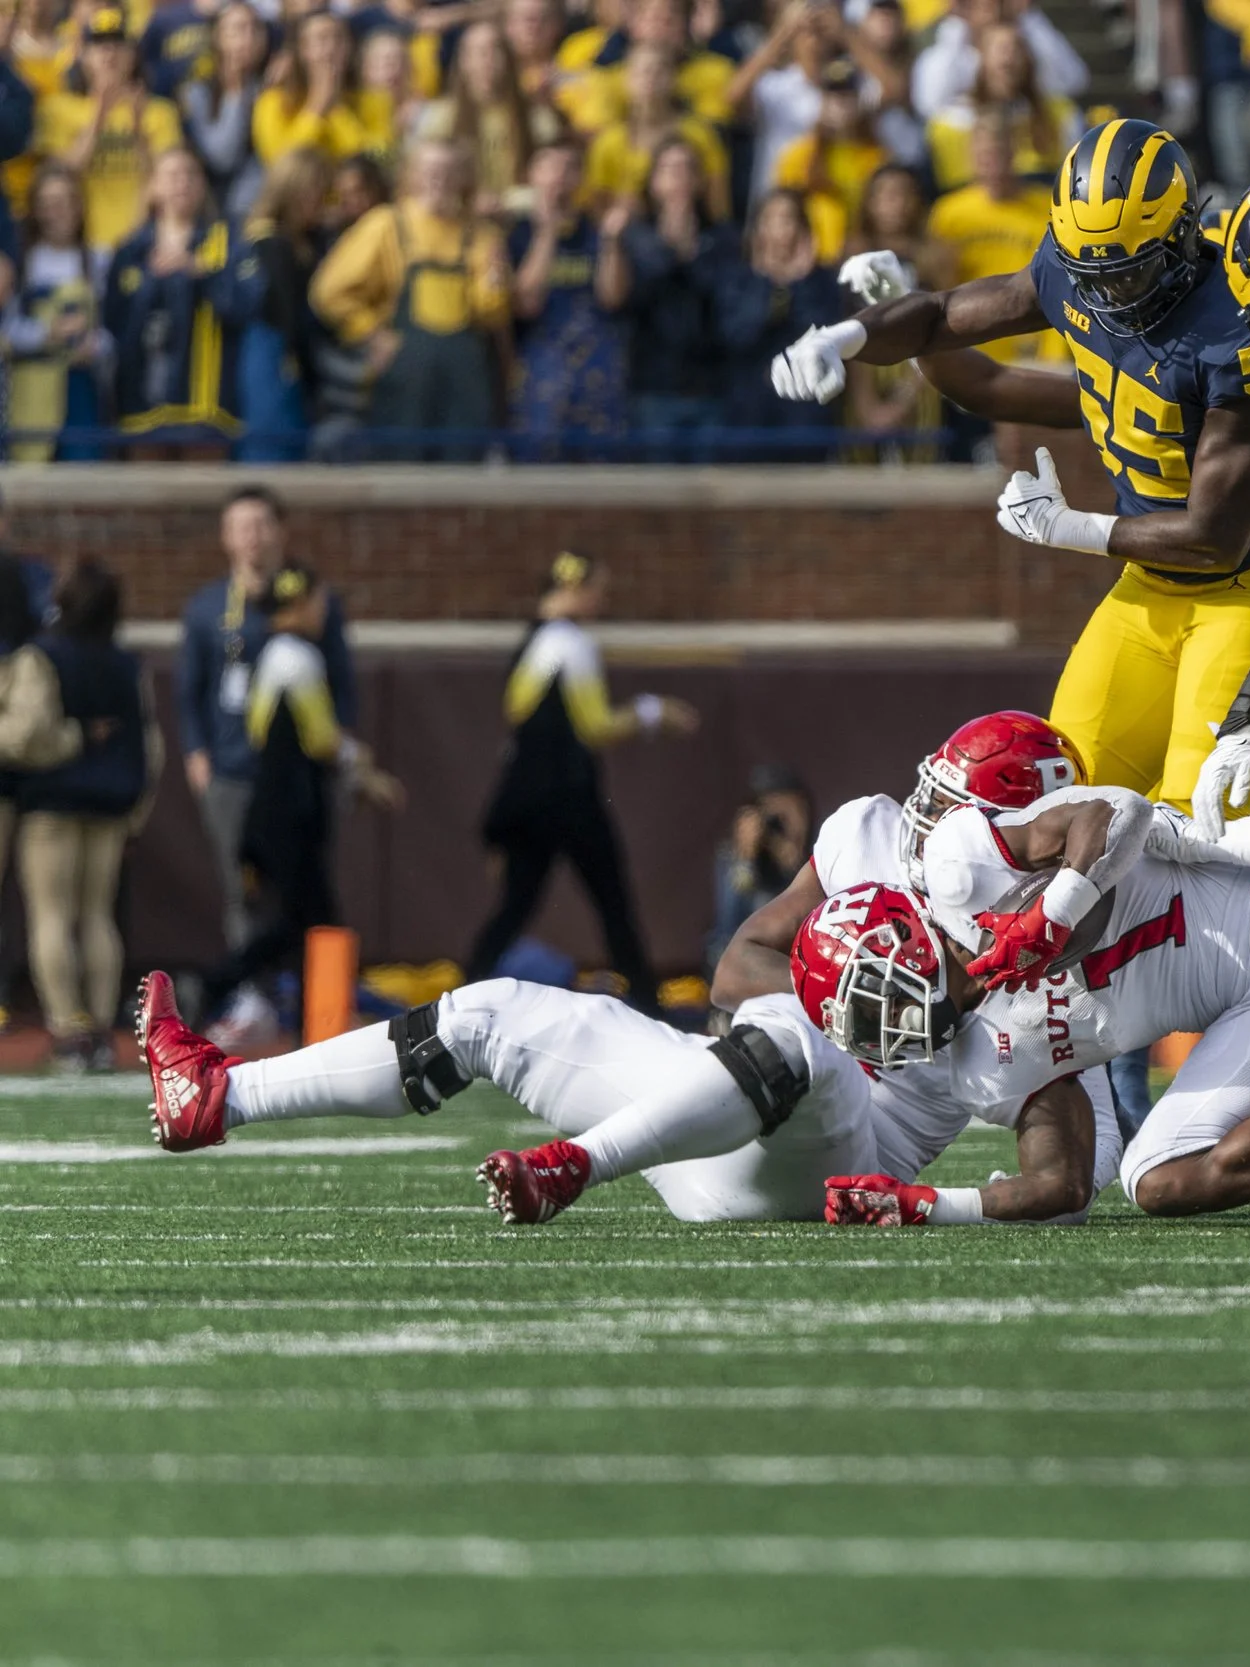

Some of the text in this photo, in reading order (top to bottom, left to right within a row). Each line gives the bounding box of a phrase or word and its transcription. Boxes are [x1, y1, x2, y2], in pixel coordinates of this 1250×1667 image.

[1092, 246, 1107, 257] M
[1064, 330, 1192, 500] 55
[813, 887, 879, 933] R
[1080, 889, 1186, 992] 1
[160, 1068, 181, 1119] adidas
